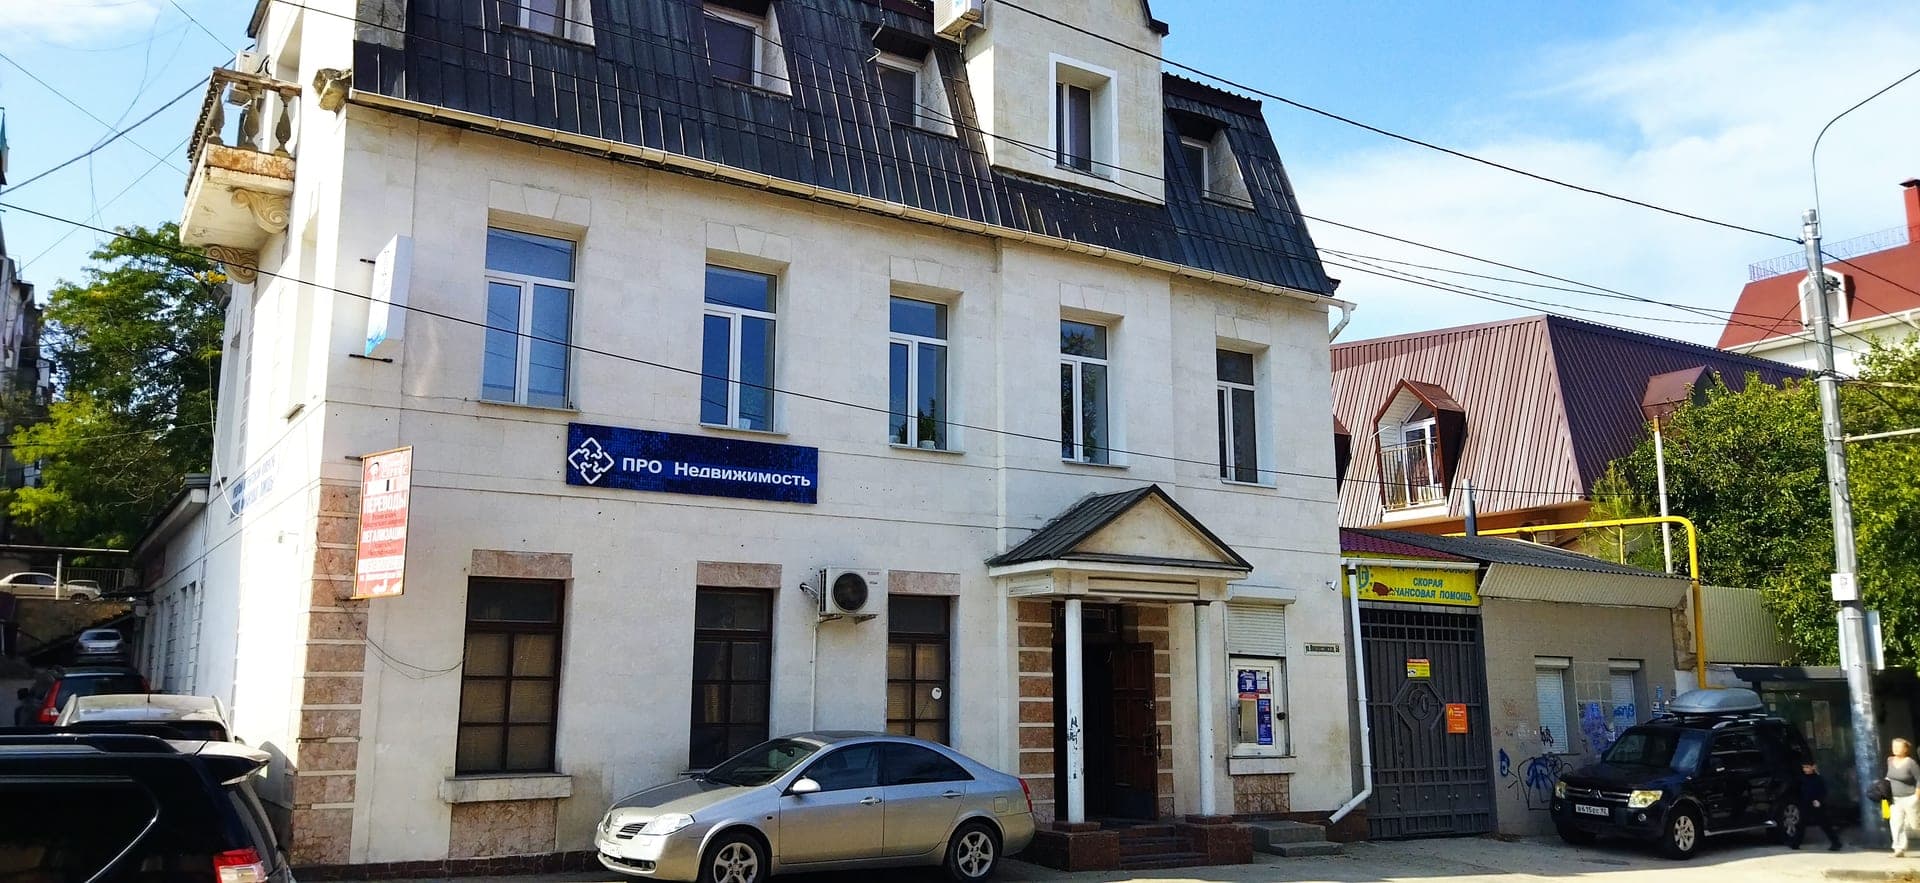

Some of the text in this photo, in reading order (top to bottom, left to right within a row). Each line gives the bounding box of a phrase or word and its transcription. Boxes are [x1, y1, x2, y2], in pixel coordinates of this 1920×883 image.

[622, 457, 811, 487] ПРО Недвижимость
[1413, 577, 1443, 588] СКОРАЯ
[1439, 590, 1473, 602] ПОМОЩЬ
